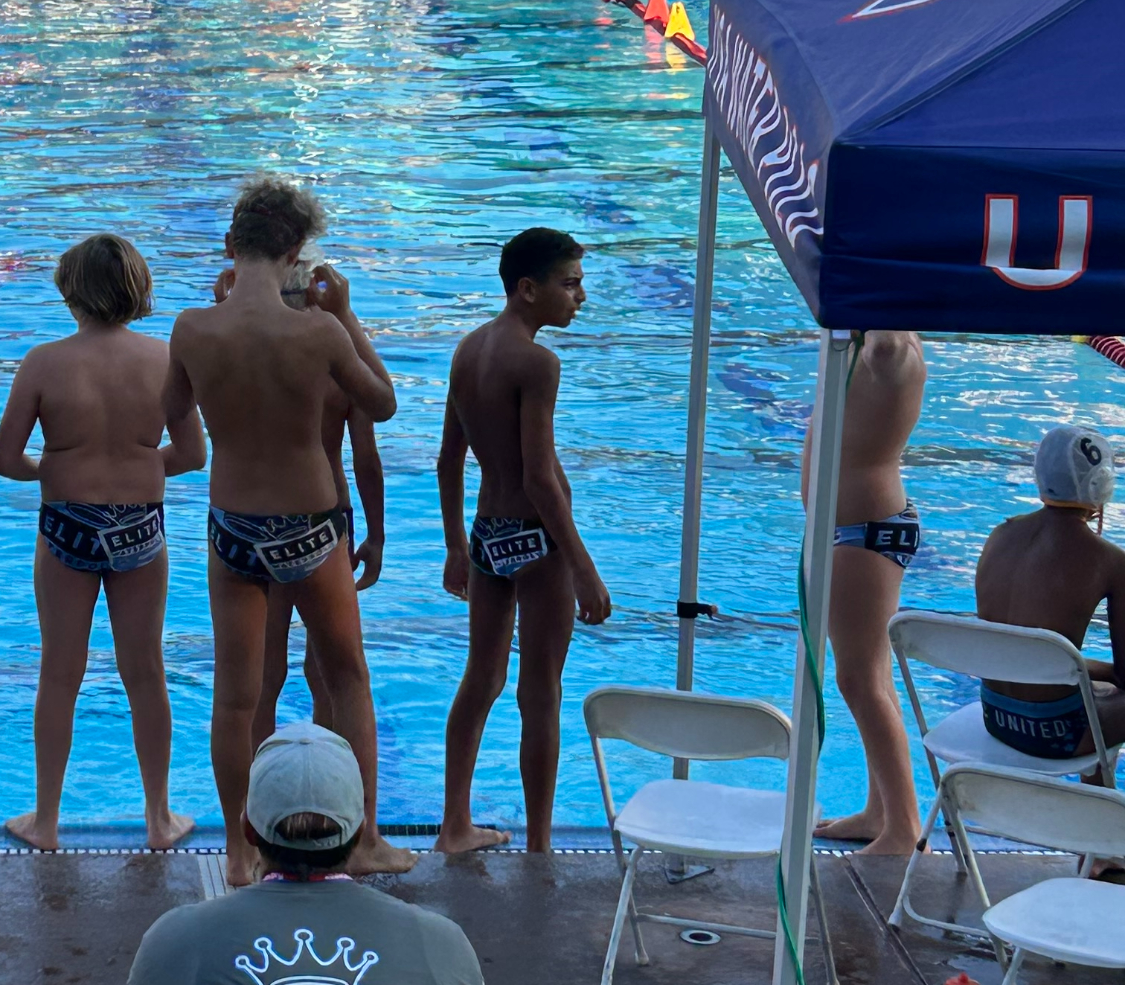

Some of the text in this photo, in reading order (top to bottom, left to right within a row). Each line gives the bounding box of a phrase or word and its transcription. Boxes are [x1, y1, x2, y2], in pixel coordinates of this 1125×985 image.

[981, 194, 1092, 291] U
[1080, 437, 1102, 466] 6
[111, 519, 158, 548] ELITE
[269, 531, 329, 560] ELITE
[491, 537, 537, 557] ELITE
[995, 709, 1066, 738] UNITED
